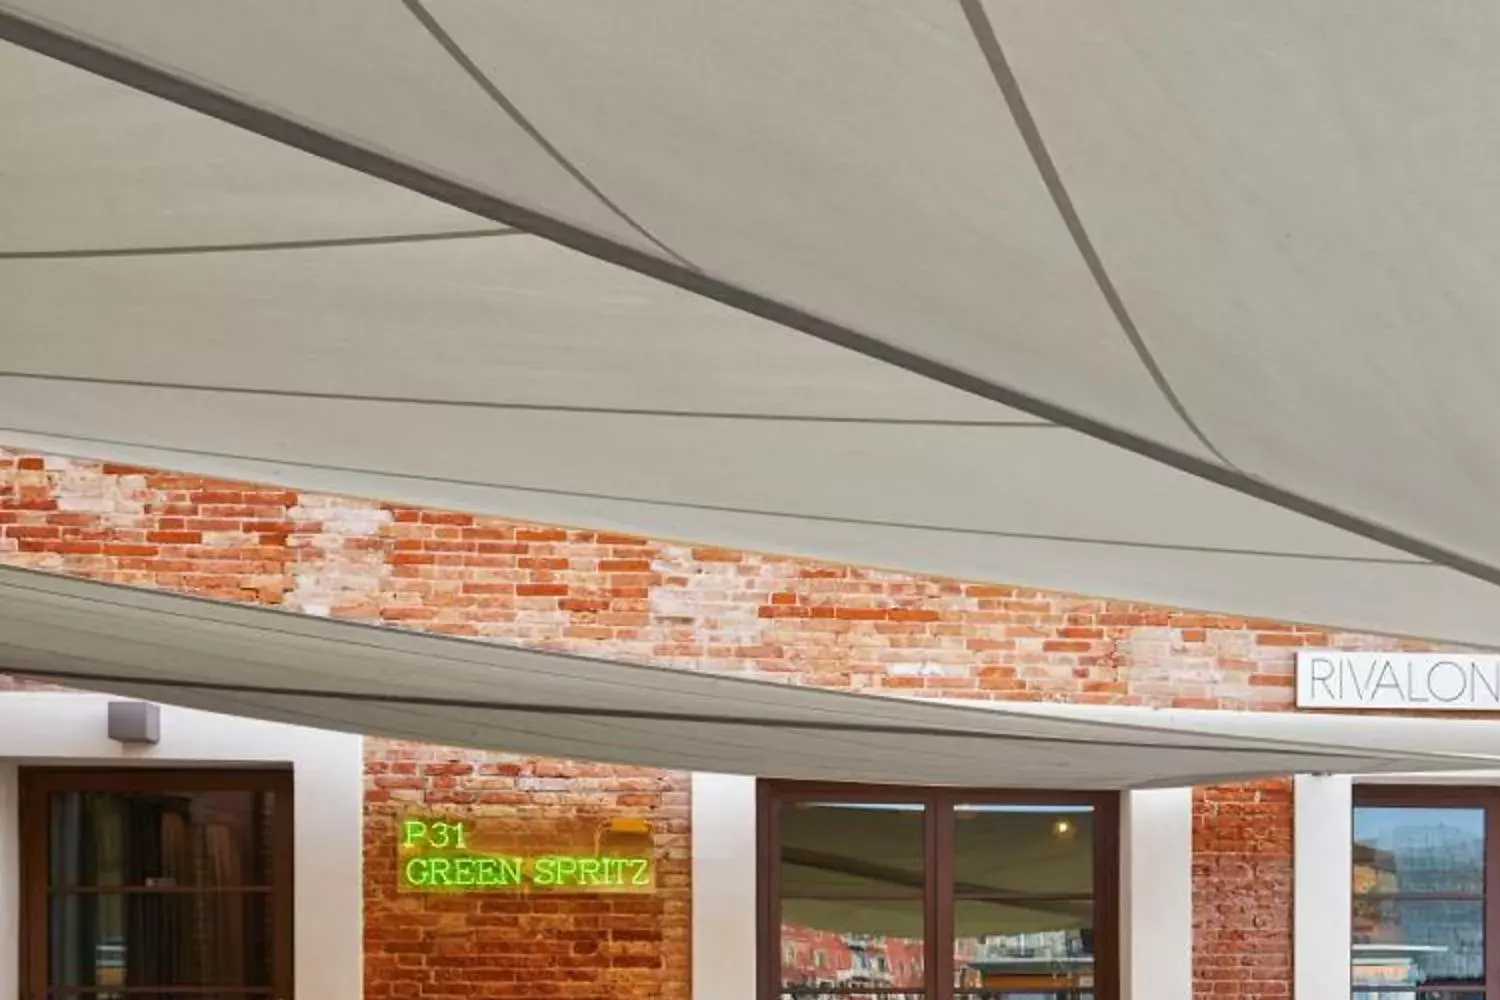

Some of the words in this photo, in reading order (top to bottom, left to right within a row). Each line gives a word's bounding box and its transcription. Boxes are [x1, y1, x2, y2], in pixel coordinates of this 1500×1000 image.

[402, 820, 467, 849] P31
[406, 856, 523, 885] GREEN
[533, 857, 650, 886] SPRITZ
